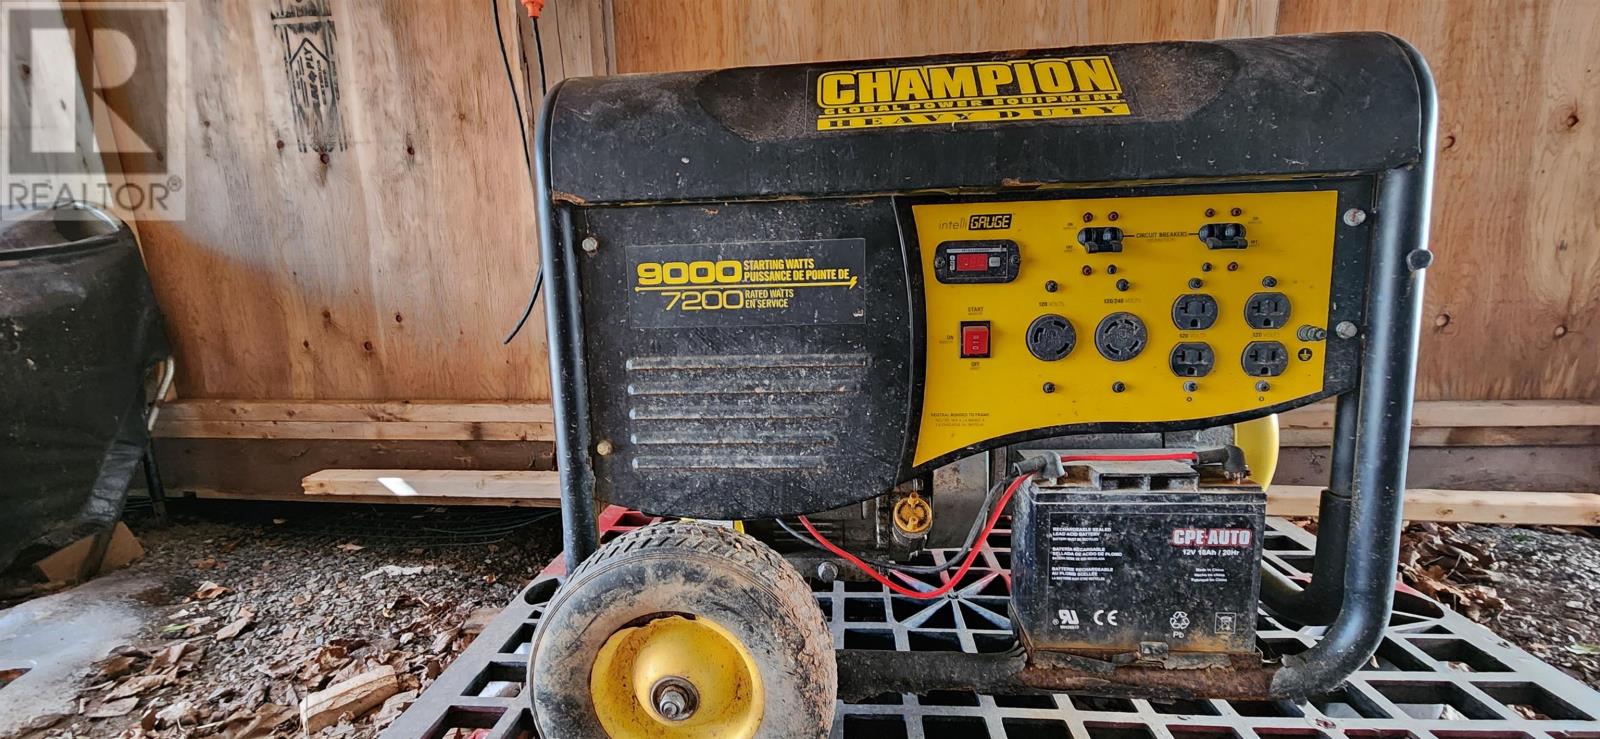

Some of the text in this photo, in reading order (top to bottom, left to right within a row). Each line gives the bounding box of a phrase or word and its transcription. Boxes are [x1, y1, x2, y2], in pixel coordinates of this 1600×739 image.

[820, 57, 1119, 107] CHAMPION
[824, 94, 1119, 115] GLOBAL POWER EQUIPMENT
[828, 105, 1119, 128] HEAVY DUTY
[969, 214, 1011, 230] GAUGE
[637, 258, 815, 285] 9000 STARTING WATTS
[744, 269, 849, 281] PUISSANCE DE POINTE DE
[661, 288, 794, 311] 7200 RATED WATTS
[745, 298, 789, 309] EN SERVICE
[1093, 609, 1118, 626] CE
[1173, 631, 1185, 639] Pb
